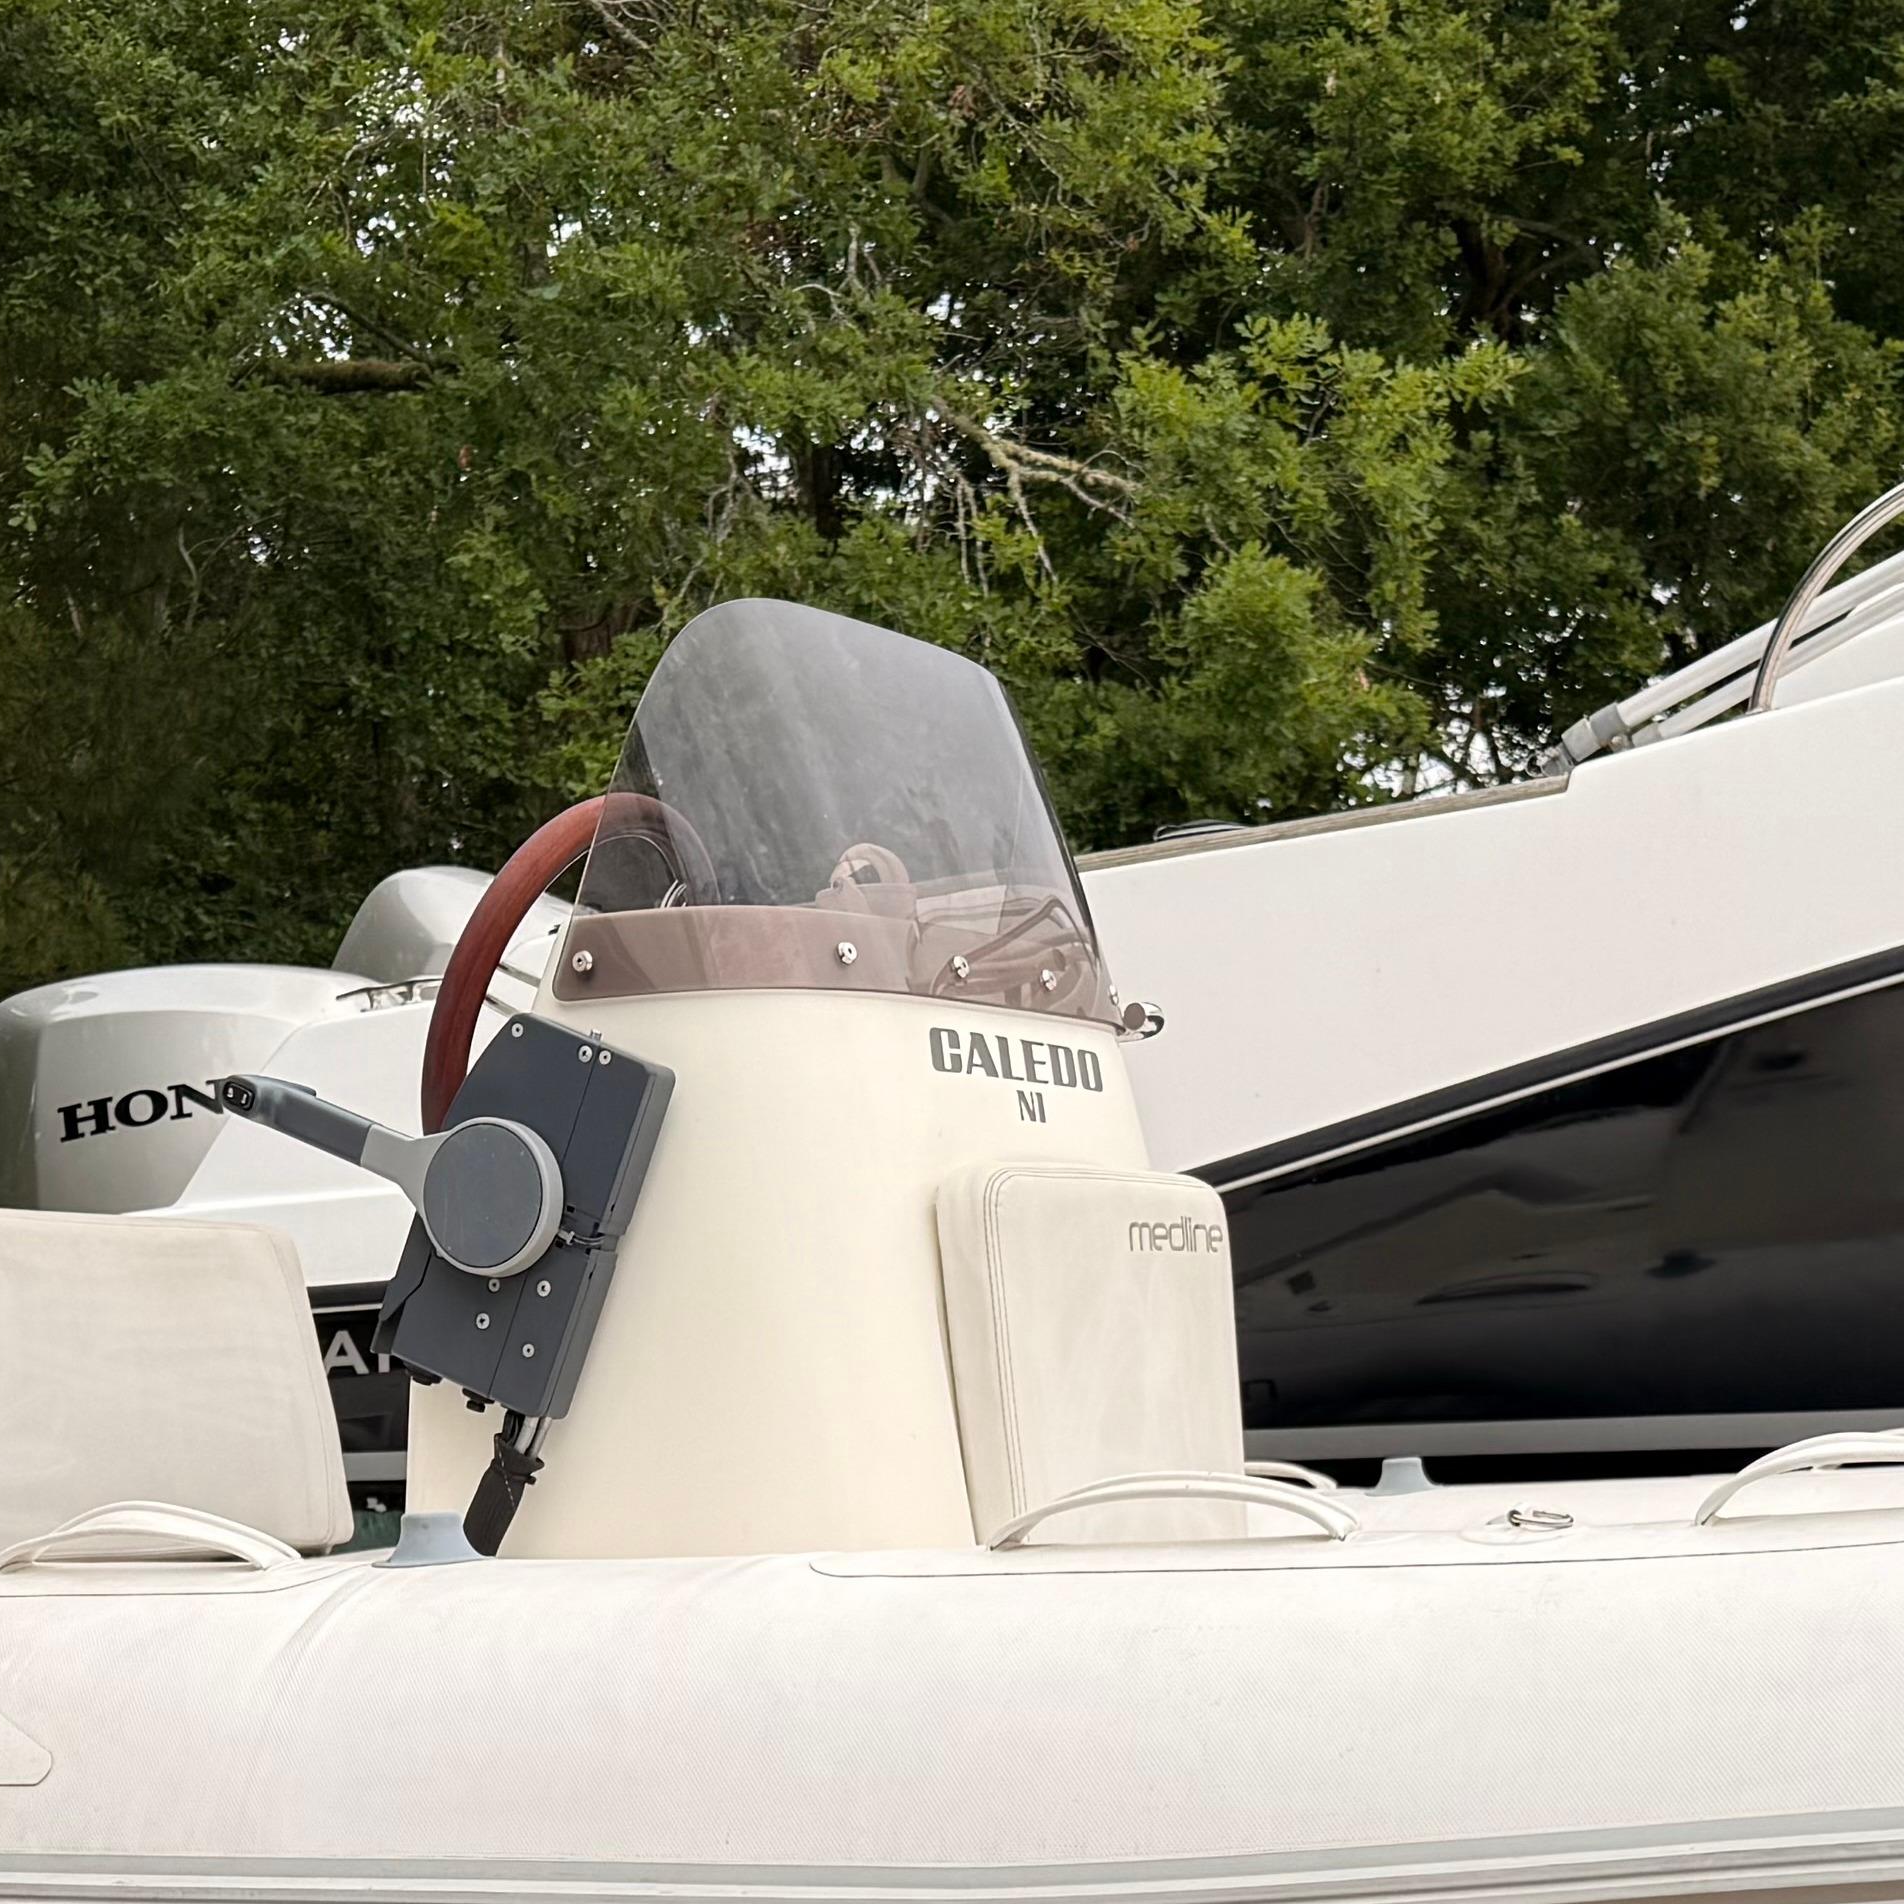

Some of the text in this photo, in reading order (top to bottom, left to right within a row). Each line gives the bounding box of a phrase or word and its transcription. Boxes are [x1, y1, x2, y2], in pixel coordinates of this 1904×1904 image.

[929, 1027, 1103, 1092] CALEDO
[57, 1077, 226, 1143] HON
[1016, 1089, 1046, 1123] NI
[1129, 1215, 1223, 1253] medline
